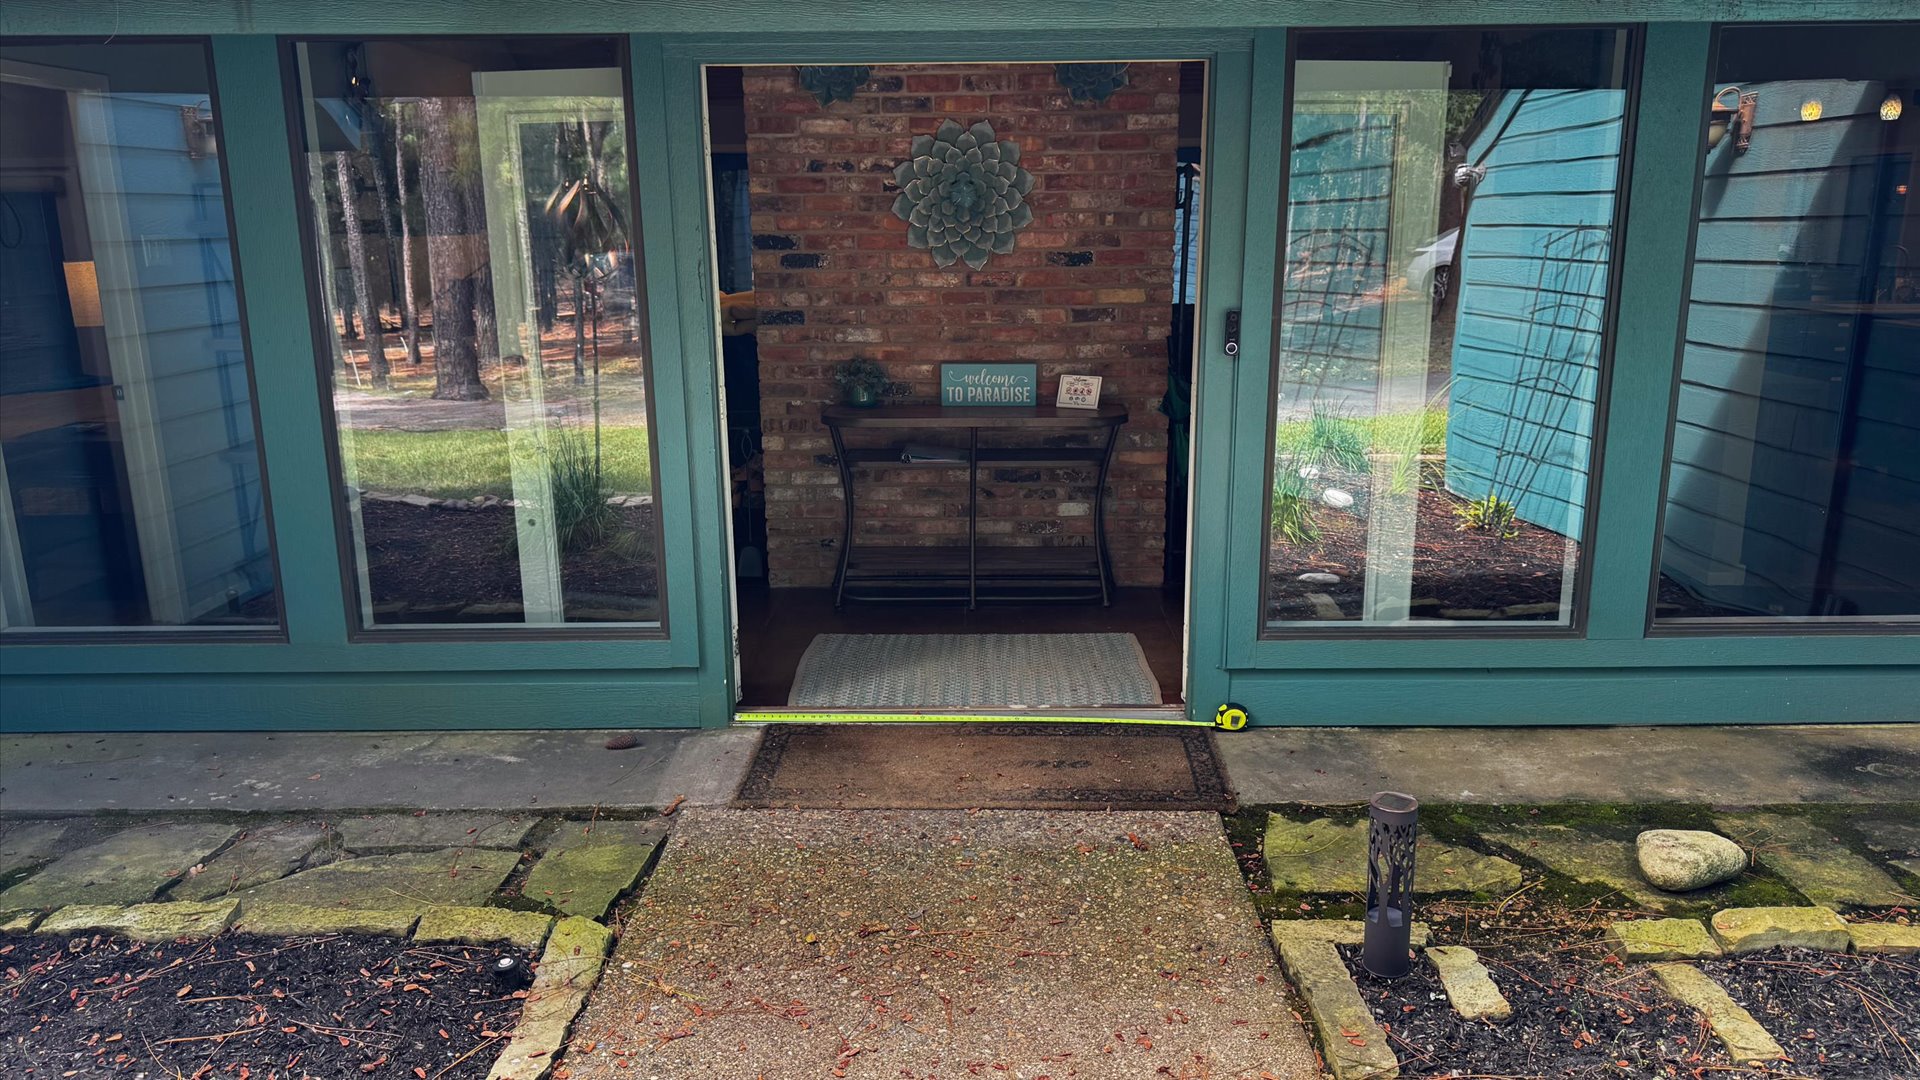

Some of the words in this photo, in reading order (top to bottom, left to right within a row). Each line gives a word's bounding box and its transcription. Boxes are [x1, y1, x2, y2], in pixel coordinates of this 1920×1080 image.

[948, 368, 1029, 387] welcome
[946, 386, 963, 402] TO
[967, 386, 1031, 402] PARADISE
